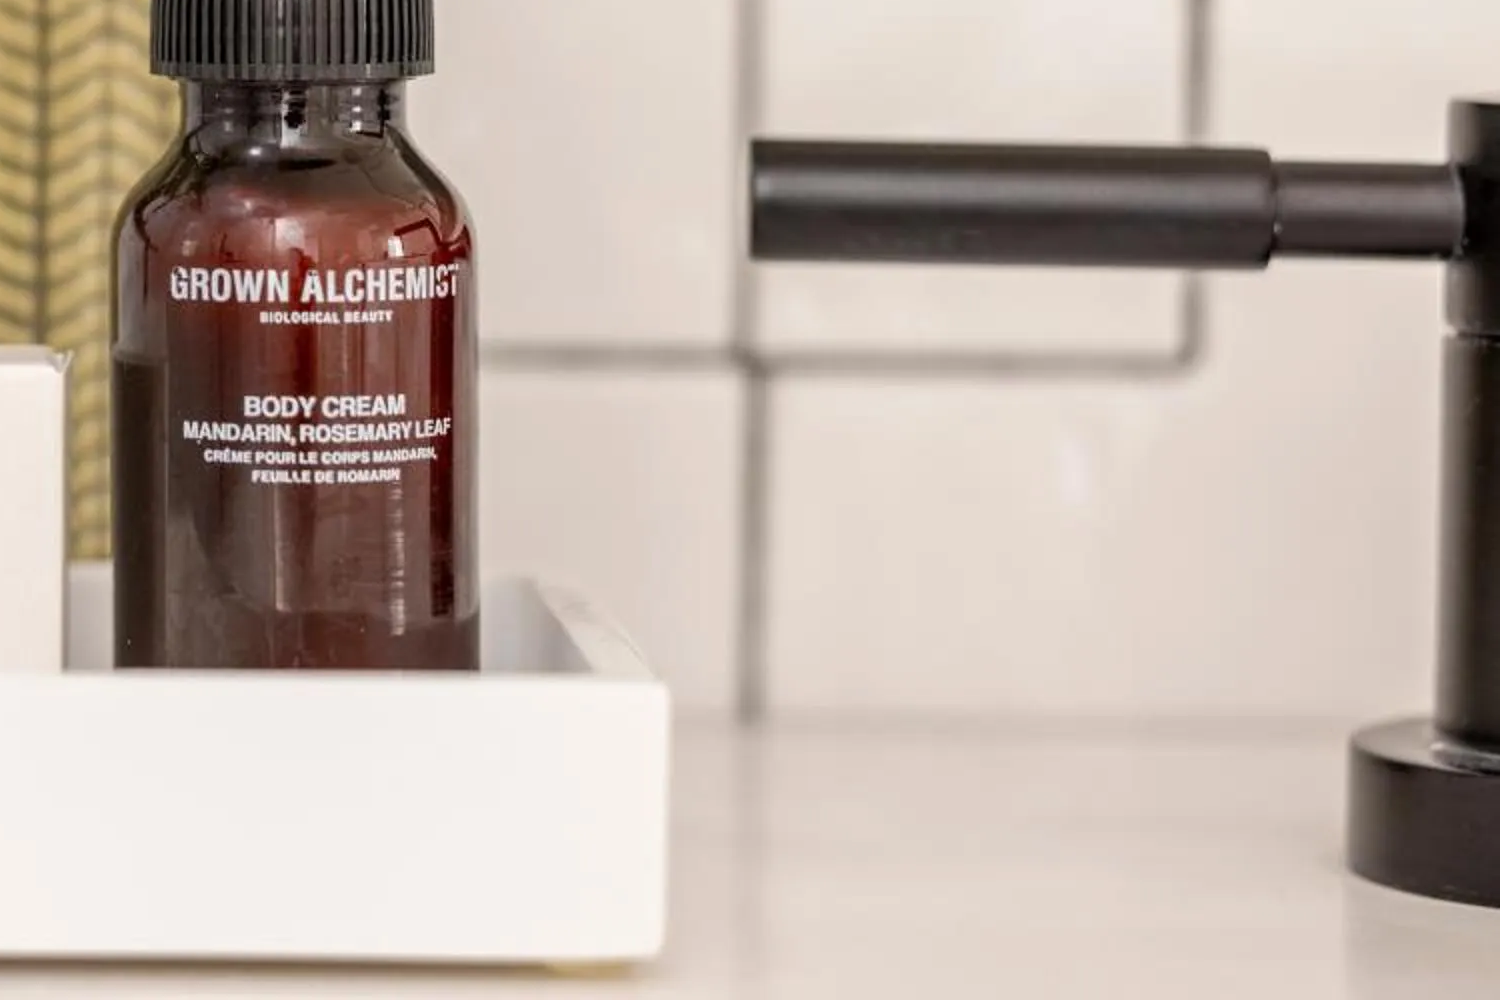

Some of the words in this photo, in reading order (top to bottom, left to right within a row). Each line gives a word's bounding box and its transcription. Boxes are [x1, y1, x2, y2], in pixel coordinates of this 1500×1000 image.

[170, 266, 289, 302] GROWN
[300, 263, 460, 302] ALCHEMIST
[259, 311, 341, 325] BIOLOGICAL
[344, 310, 394, 324] BEAUTY
[243, 395, 316, 419] BODY
[321, 393, 407, 418] CREAM
[299, 421, 413, 443] ROSEMARY
[415, 416, 452, 438] LEAF
[255, 451, 296, 465] POUR
[299, 451, 318, 465] LE
[321, 450, 370, 464] CORPS
[252, 469, 312, 484] FEUILLE
[314, 470, 334, 484] DE
[337, 468, 401, 484] ROMARIN
